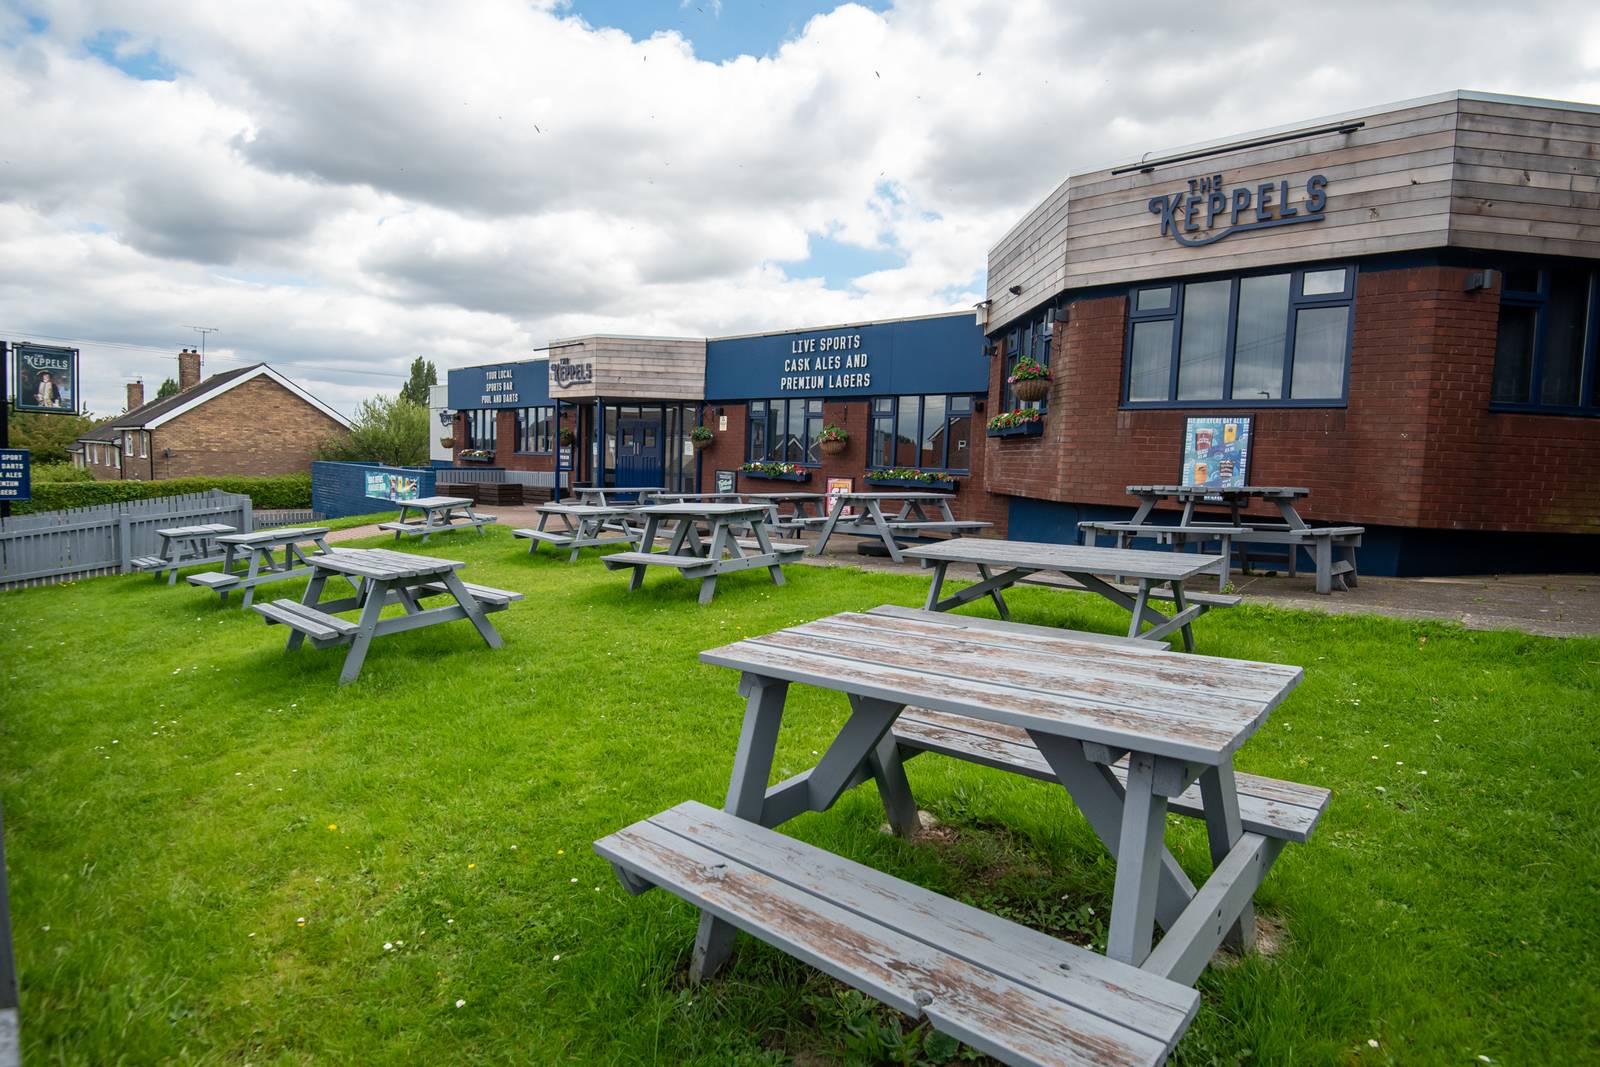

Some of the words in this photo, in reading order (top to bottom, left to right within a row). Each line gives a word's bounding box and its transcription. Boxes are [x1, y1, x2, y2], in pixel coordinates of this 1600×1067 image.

[1187, 174, 1223, 195] THE
[1149, 174, 1328, 247] KEPPELS
[792, 339, 816, 354] LIVE
[820, 334, 860, 351] SPORTS
[23, 355, 69, 370] KEPPELS
[784, 358, 810, 372] CASK
[815, 355, 841, 370] ALES
[846, 353, 868, 369] AND
[486, 371, 498, 380] YOUR
[498, 369, 513, 379] LOCAL
[550, 362, 592, 389] KEPPELS
[780, 375, 824, 390] PREMIUM
[829, 373, 871, 389] LAGERS
[486, 382, 502, 392] SPORTS
[503, 381, 513, 391] BAR
[481, 395, 492, 404] POOL
[493, 394, 502, 403] AND
[503, 393, 519, 403] DARTS
